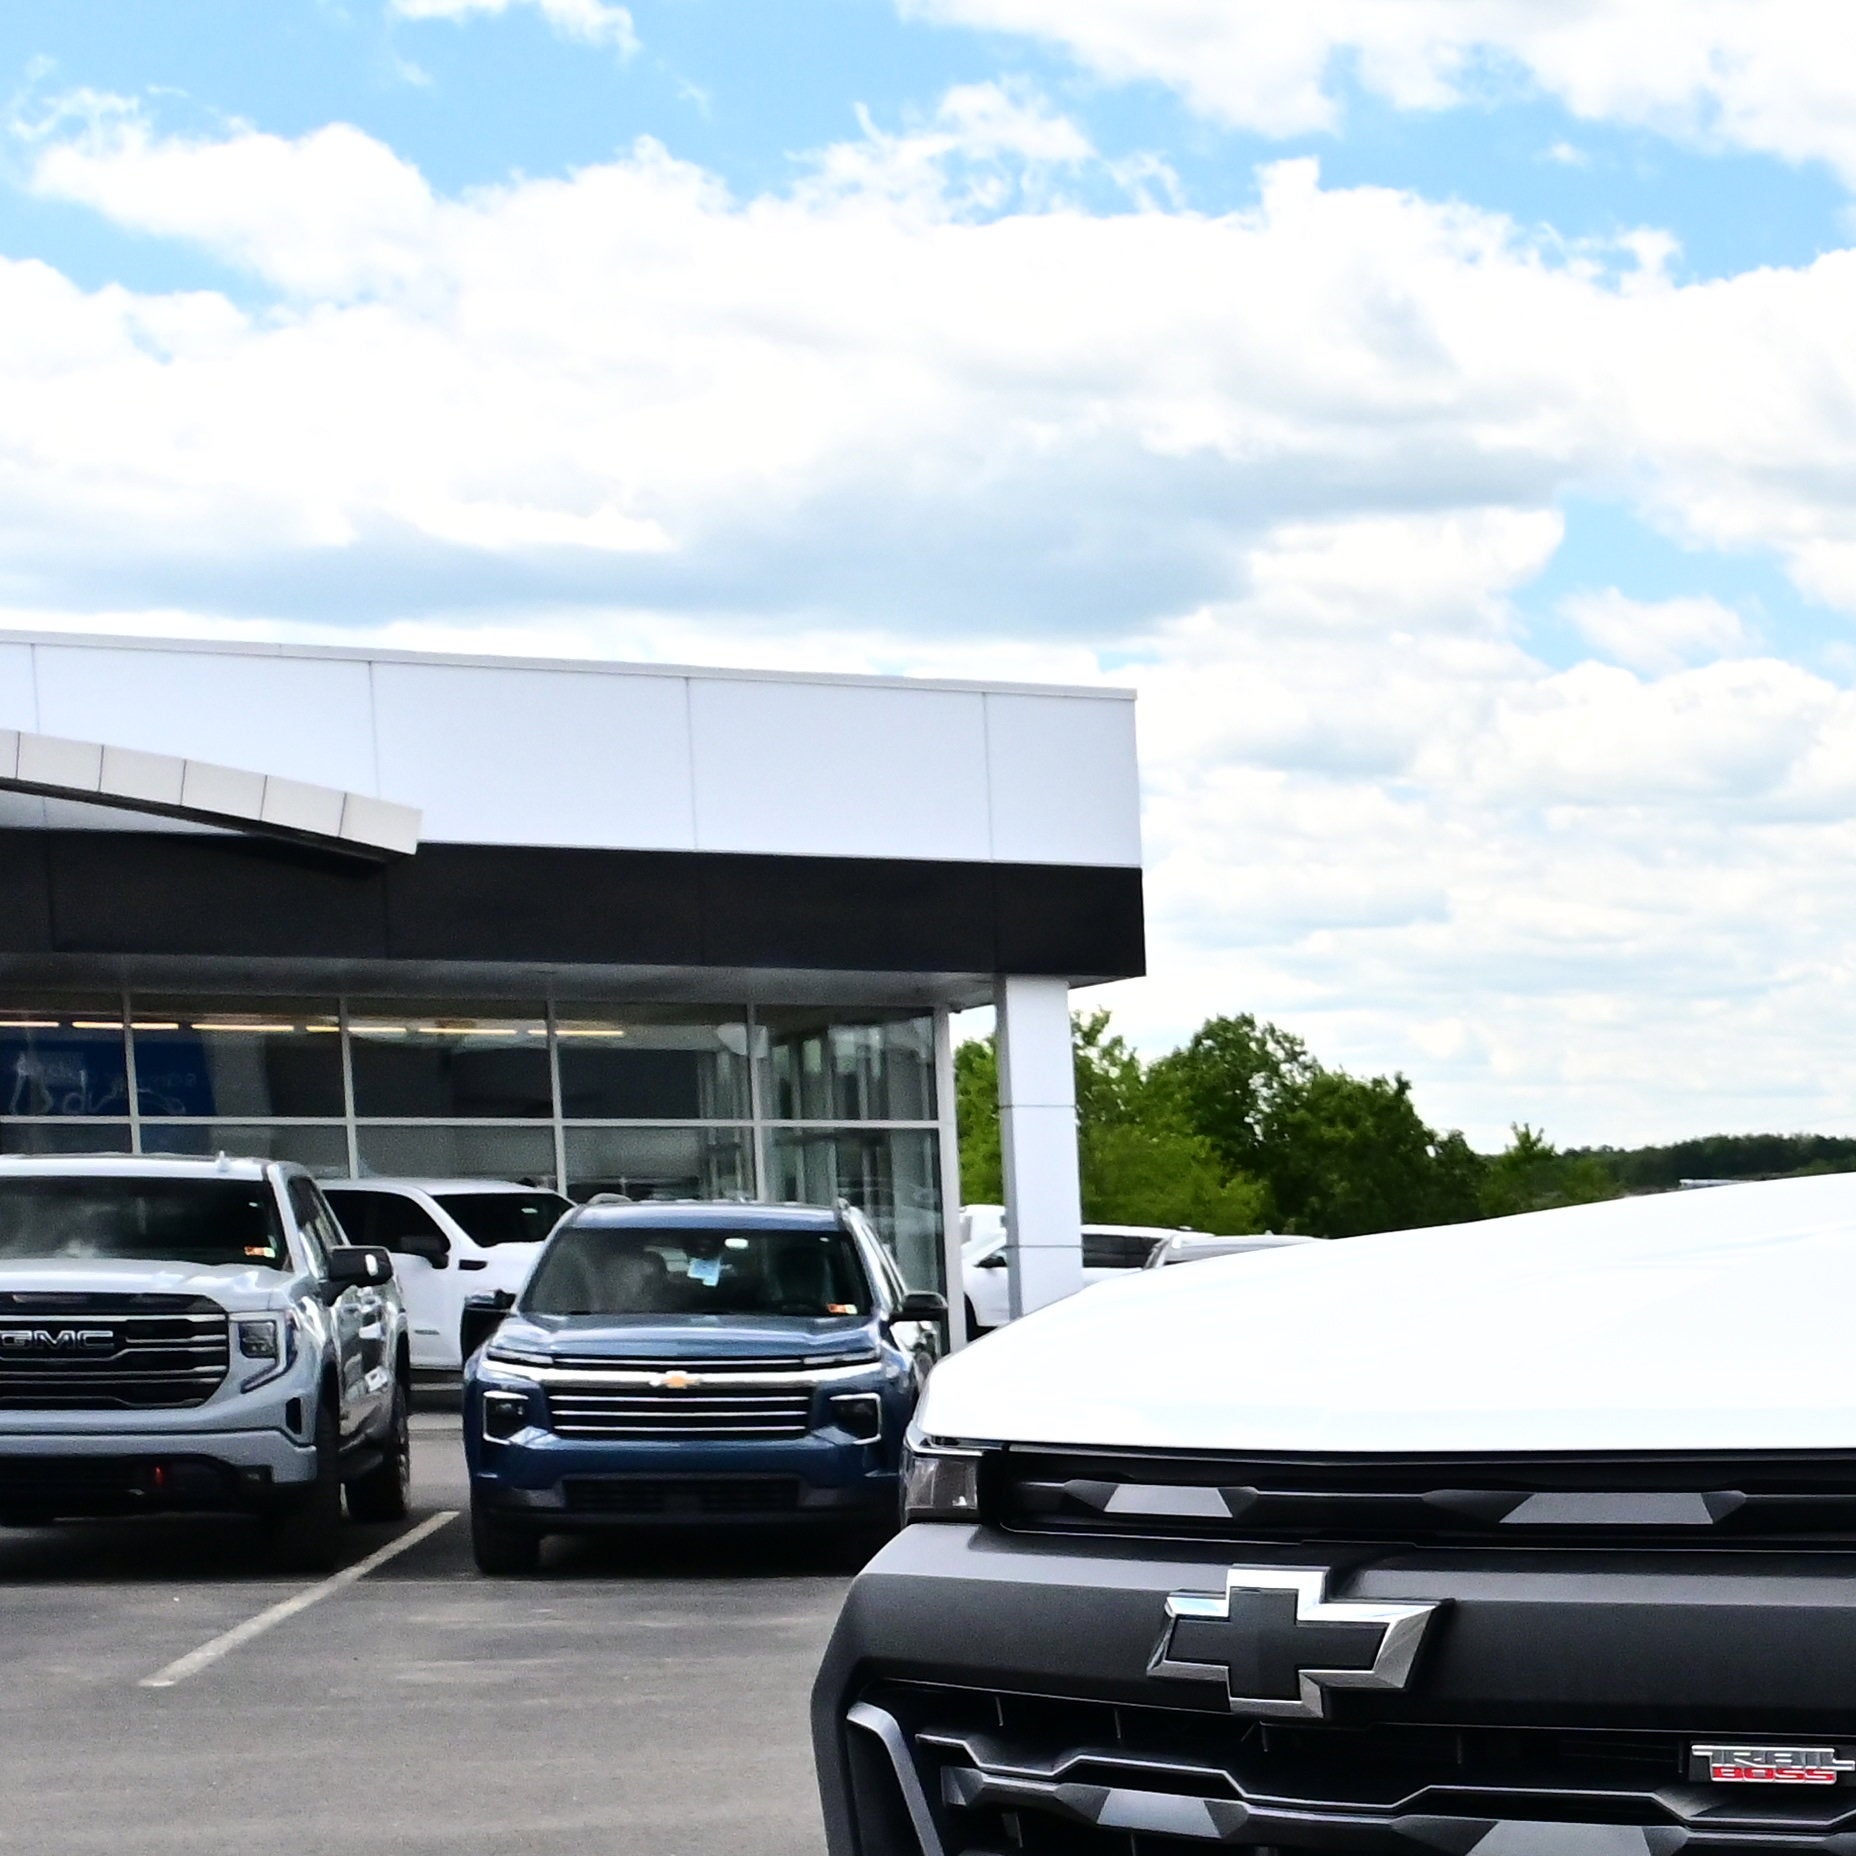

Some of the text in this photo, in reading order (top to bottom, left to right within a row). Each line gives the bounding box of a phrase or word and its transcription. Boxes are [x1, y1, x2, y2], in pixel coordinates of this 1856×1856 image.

[0, 1329, 115, 1350] GMC
[1691, 1744, 1856, 1771] TRAIL
[1711, 1765, 1837, 1785] BOSS
